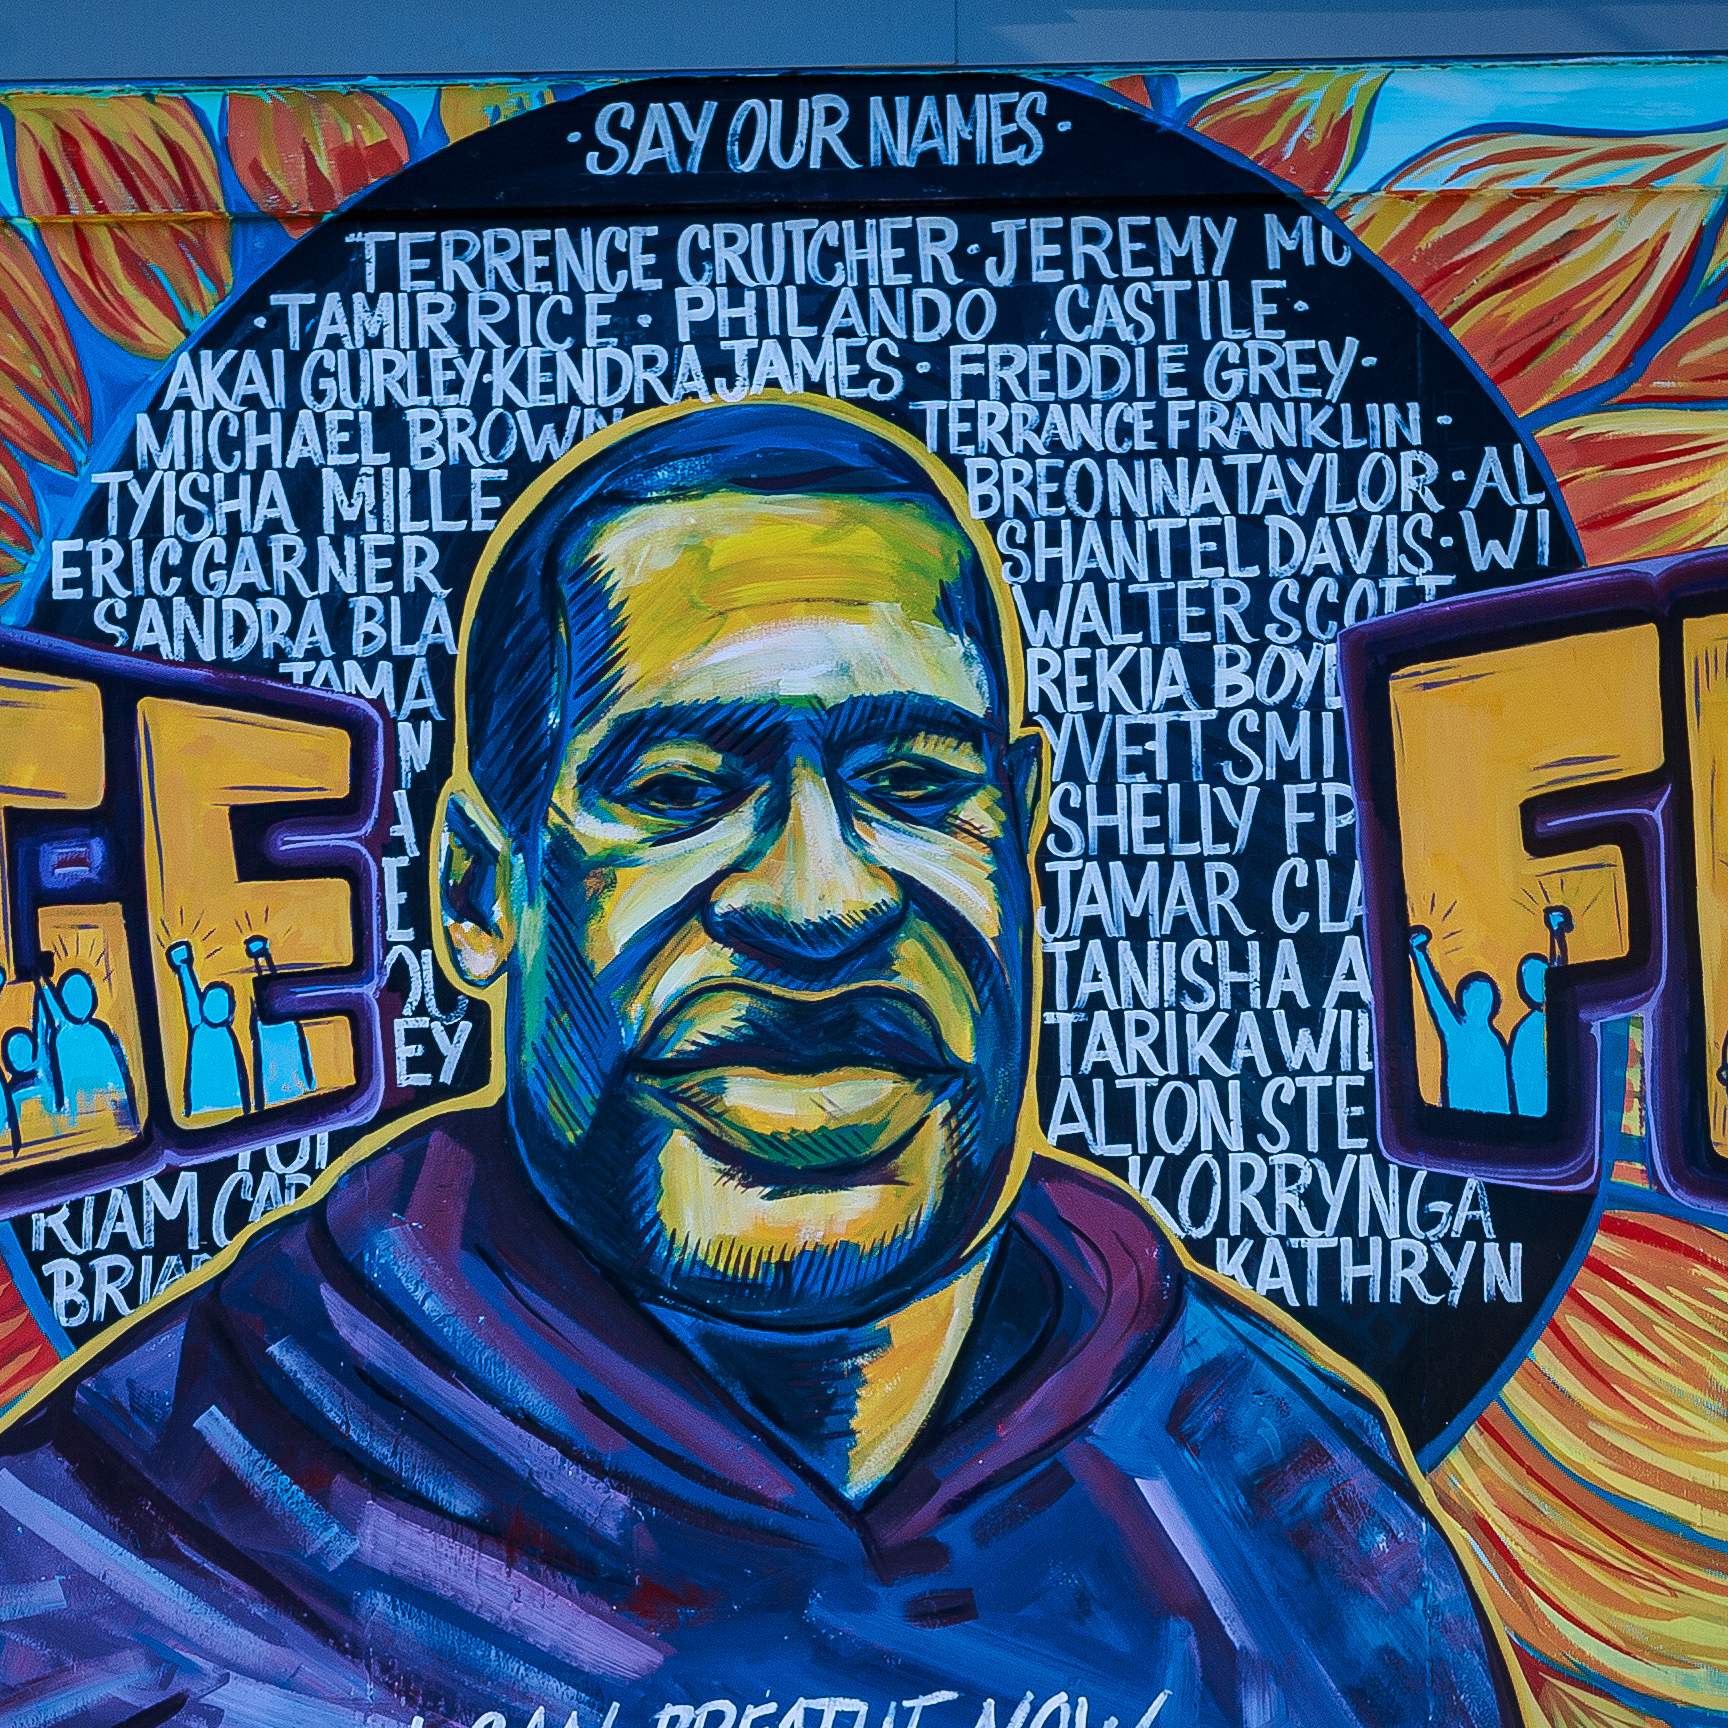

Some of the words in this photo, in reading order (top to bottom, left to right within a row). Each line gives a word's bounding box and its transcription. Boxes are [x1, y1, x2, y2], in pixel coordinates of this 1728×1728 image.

[586, 98, 719, 175] SAY
[728, 94, 863, 173] OUR
[870, 91, 1047, 167] NAMES
[346, 223, 662, 293] TERRENCE
[677, 217, 966, 291] CRUTCHER
[986, 216, 1236, 287] JEREMY
[271, 293, 466, 351] TAMIR
[475, 293, 617, 348] RICE
[676, 284, 996, 342] PHILANDO
[1055, 281, 1287, 344] CASTILE
[161, 349, 286, 411] AKAI
[949, 343, 1190, 402] FREDDIE
[1204, 337, 1361, 402] GREY
[136, 409, 391, 471] MICHAEL
[910, 401, 1158, 455] TERRANCE
[1166, 401, 1423, 452] FRANKLIN
[91, 470, 299, 544] TYISHA
[322, 467, 509, 534] MILLE
[968, 456, 1226, 521] BREONNA
[1220, 451, 1440, 516] TAYLOR
[1466, 446, 1546, 508] AL
[51, 539, 189, 601] ERIC
[192, 537, 453, 602] GARNER
[1001, 514, 1260, 584] SHANTEL
[1266, 513, 1434, 578] DAVIS
[93, 598, 336, 664] SANDRA
[352, 597, 459, 657] BLA
[1012, 577, 1251, 648] WALTER
[1027, 645, 1200, 714] REKIA
[1034, 709, 1219, 784] YVETT
[1222, 708, 1336, 786] SMI
[1046, 782, 1261, 857] SHELLY
[1036, 860, 1257, 944] JAMAR
[1042, 935, 1313, 1011] TANISHA
[1042, 1009, 1271, 1078] TARIKA
[1047, 1075, 1245, 1158] ALTON
[1256, 1075, 1371, 1154] STE
[1215, 1236, 1524, 1308] KATHRYN
